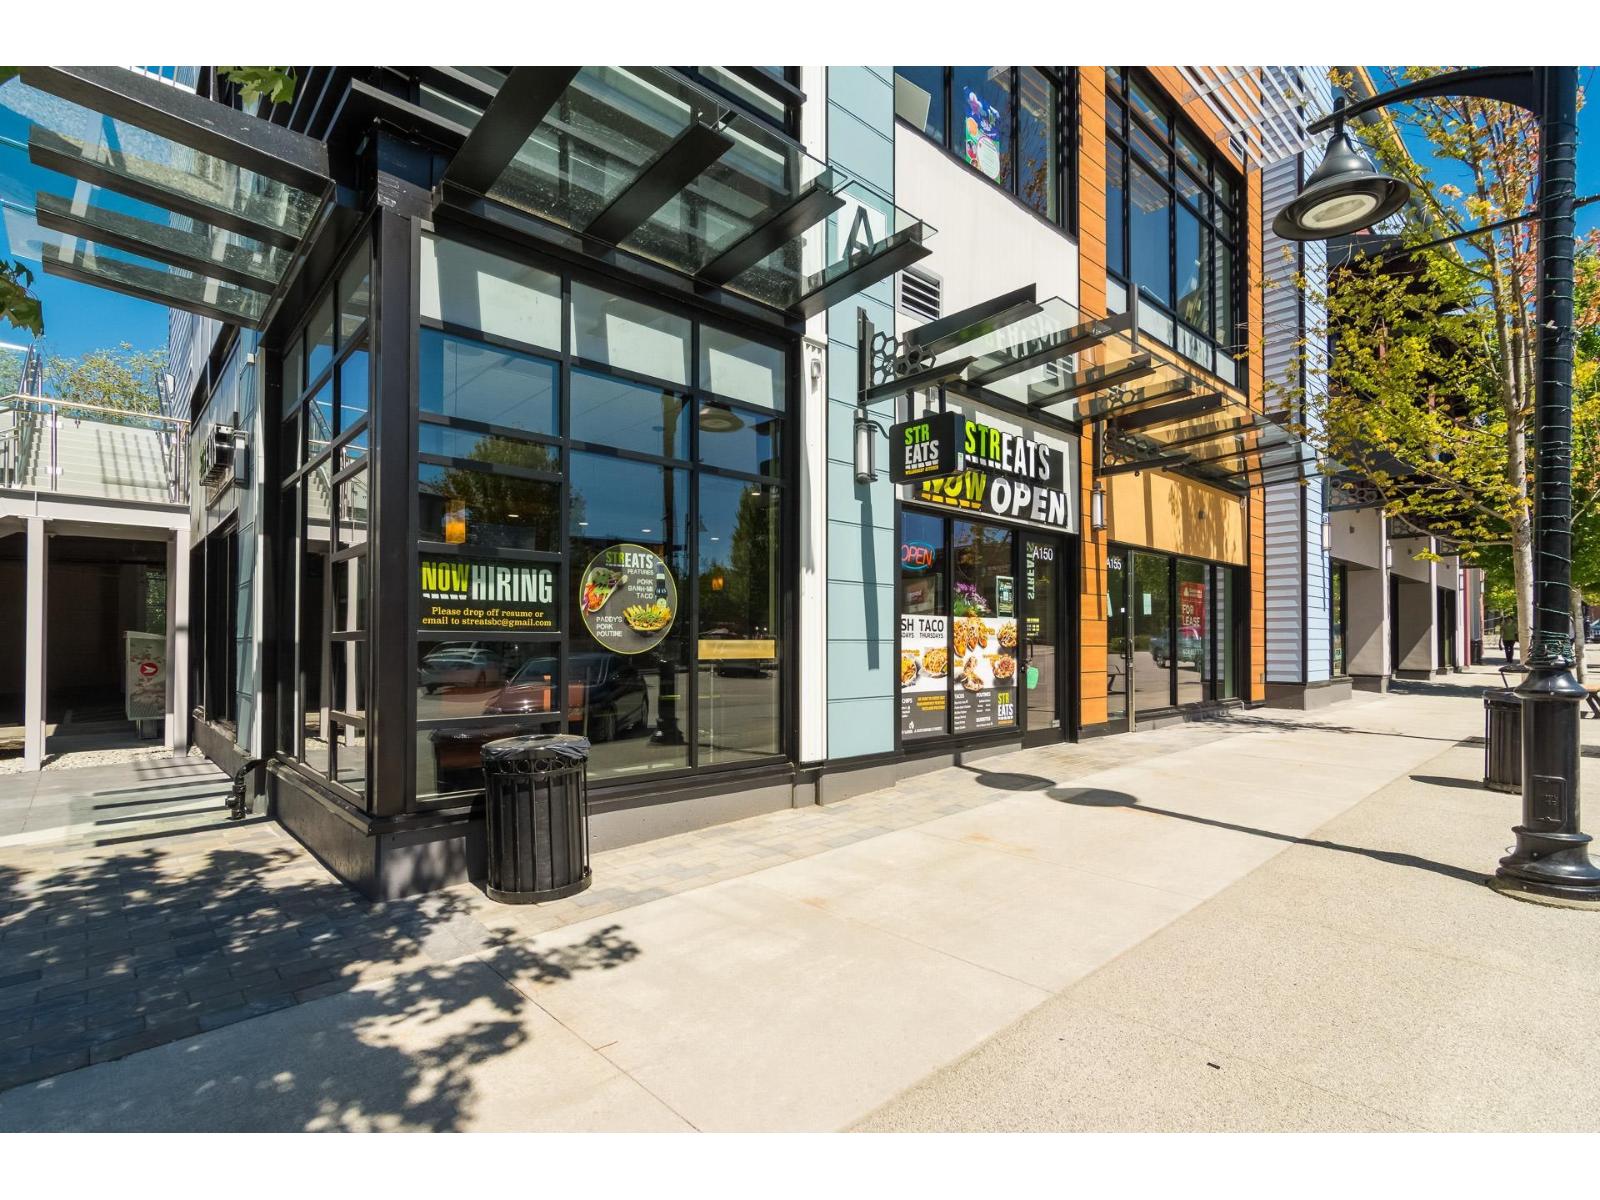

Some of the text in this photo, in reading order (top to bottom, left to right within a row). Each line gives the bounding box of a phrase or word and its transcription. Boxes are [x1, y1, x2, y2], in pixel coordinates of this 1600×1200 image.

[842, 205, 876, 261] A
[905, 423, 930, 446] STR
[905, 440, 939, 465] EATS
[965, 420, 1050, 481] STREATS
[990, 477, 1066, 525] OPEN
[606, 551, 654, 569] STREATS
[901, 544, 932, 569] OPEN
[1033, 546, 1053, 561] A150
[422, 561, 553, 604] NOW HIRING
[431, 606, 461, 616] Please
[463, 607, 485, 618] drop
[486, 608, 499, 617] off
[501, 610, 533, 618] resume
[1182, 604, 1194, 615] FOR
[422, 617, 552, 628] email to streatsbc@gmail.com
[918, 619, 944, 633] TACO
[1182, 616, 1200, 627] LEASE
[998, 692, 1009, 705] STR
[998, 703, 1014, 717] EATS
